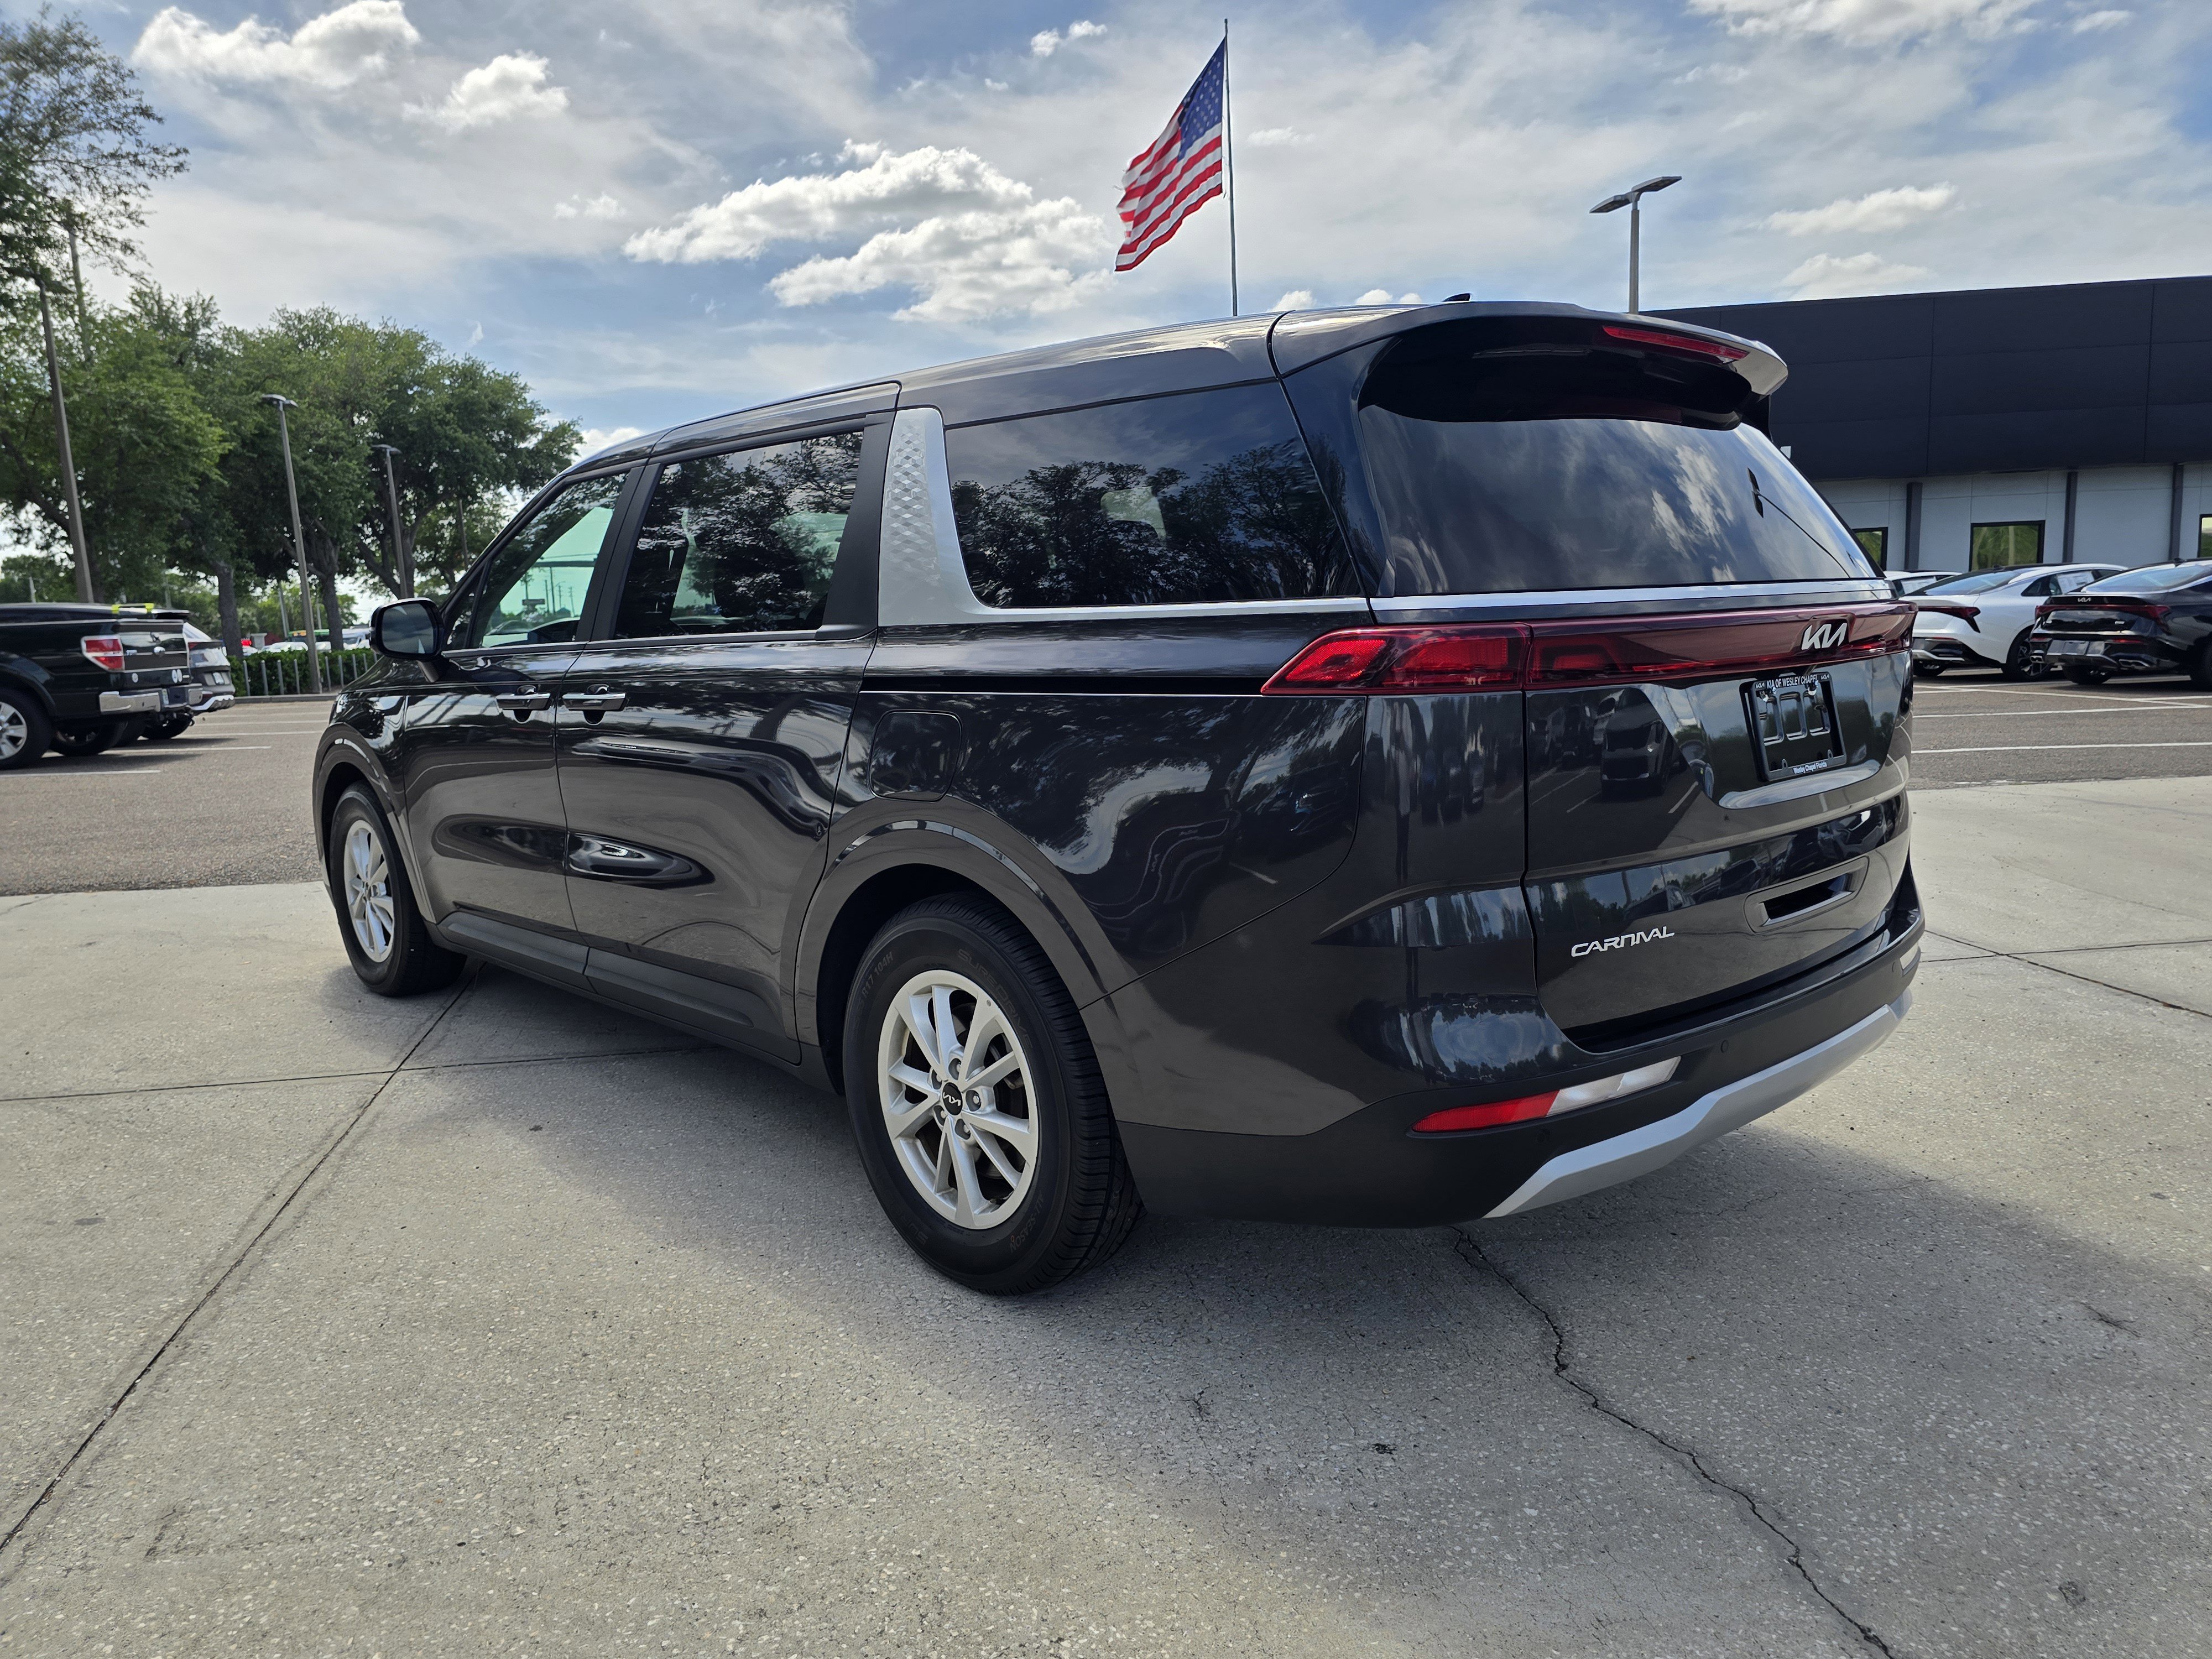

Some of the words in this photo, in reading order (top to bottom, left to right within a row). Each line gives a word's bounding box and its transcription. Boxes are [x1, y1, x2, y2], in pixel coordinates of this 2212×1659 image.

[1801, 623, 1848, 650] KIA
[1775, 678, 1782, 688] OF
[1782, 675, 1800, 687] WESLEY
[1571, 926, 1675, 957] CARNIVAL
[862, 974, 874, 998] R17
[874, 951, 894, 975] 104H
[957, 948, 1033, 1048] SUREDRIVE
[1010, 1190, 1044, 1253] ALL-SEASON
